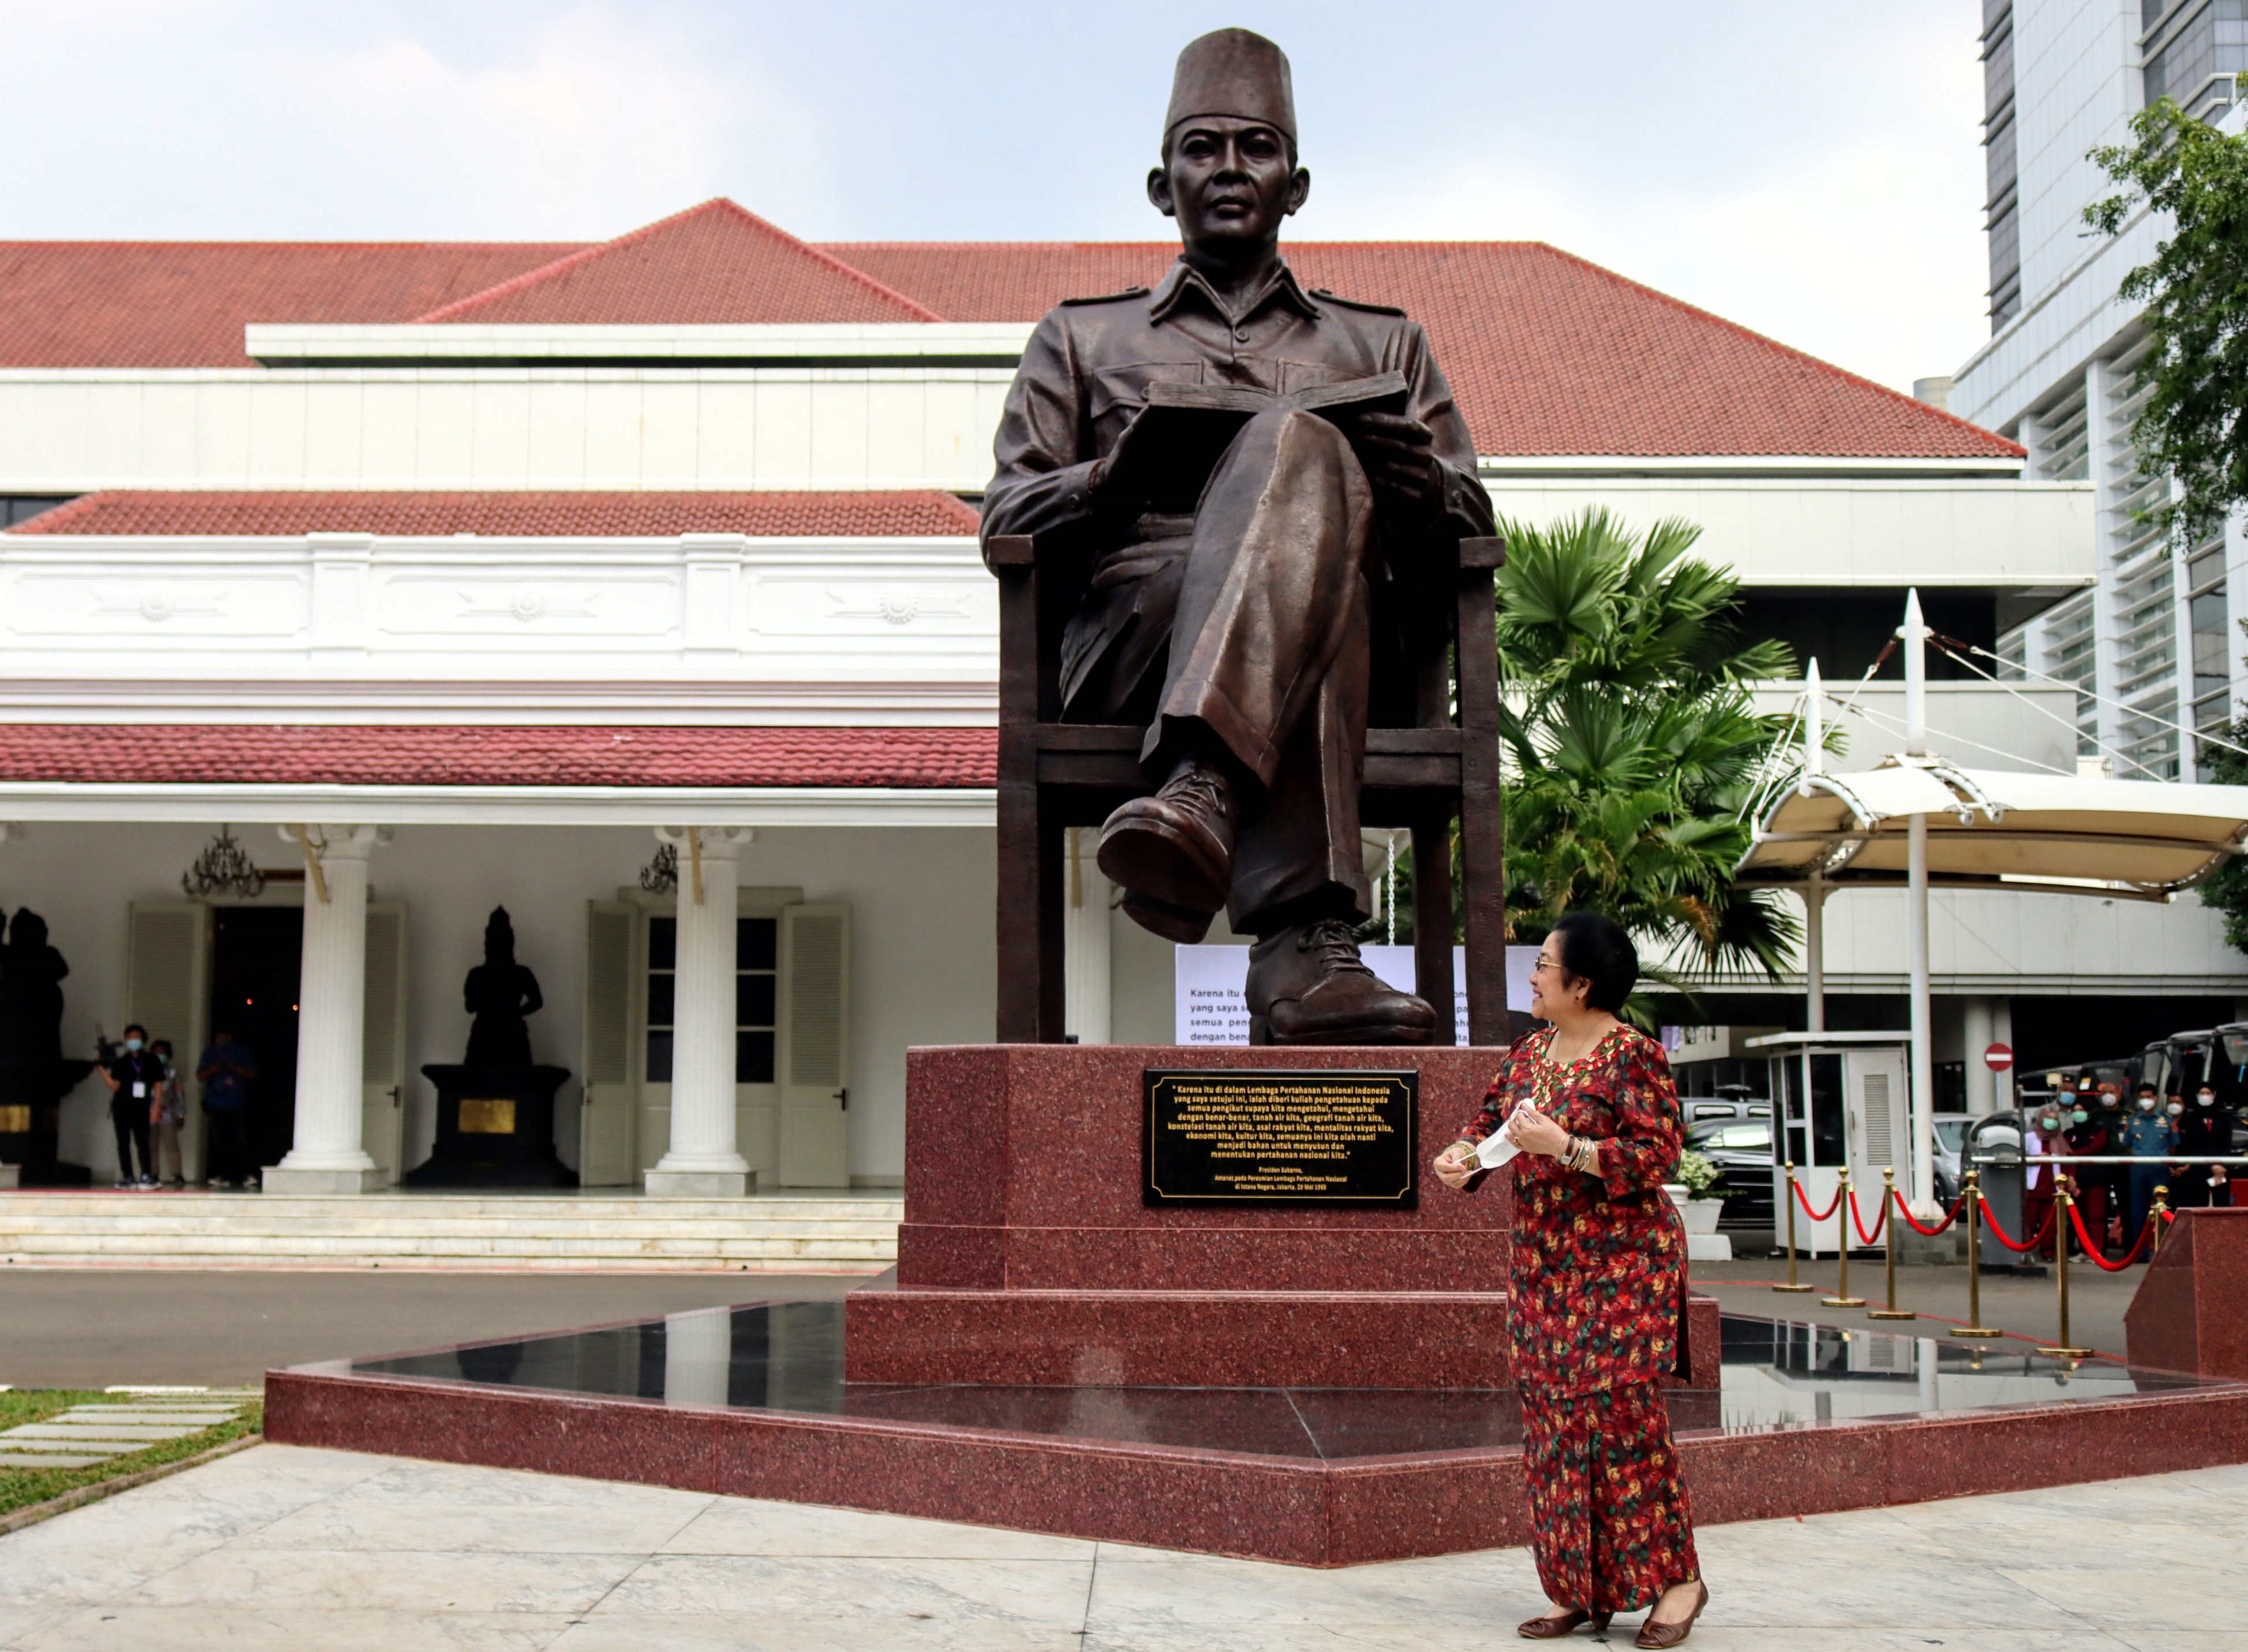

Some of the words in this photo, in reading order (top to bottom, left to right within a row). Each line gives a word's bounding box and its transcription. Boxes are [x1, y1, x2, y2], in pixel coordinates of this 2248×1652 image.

[1191, 1005, 1213, 1013] yang
[1217, 1005, 1237, 1013] saya
[1191, 1033, 1226, 1042] dengan
[1247, 1086, 1278, 1095] Lembaga
[1210, 1095, 1234, 1104] setujui
[1314, 1096, 1361, 1105] pengetahuan
[1362, 1096, 1388, 1105] kepada
[1212, 1105, 1243, 1114] pengikut
[1332, 1105, 1374, 1114] mengetahui
[1177, 1114, 1204, 1122] dengan
[1303, 1114, 1333, 1123] geografi
[1272, 1124, 1295, 1132] rakyat
[1353, 1124, 1376, 1133] rakyat
[1217, 1141, 1246, 1151] menjadi
[1257, 1151, 1298, 1160] pertahanan
